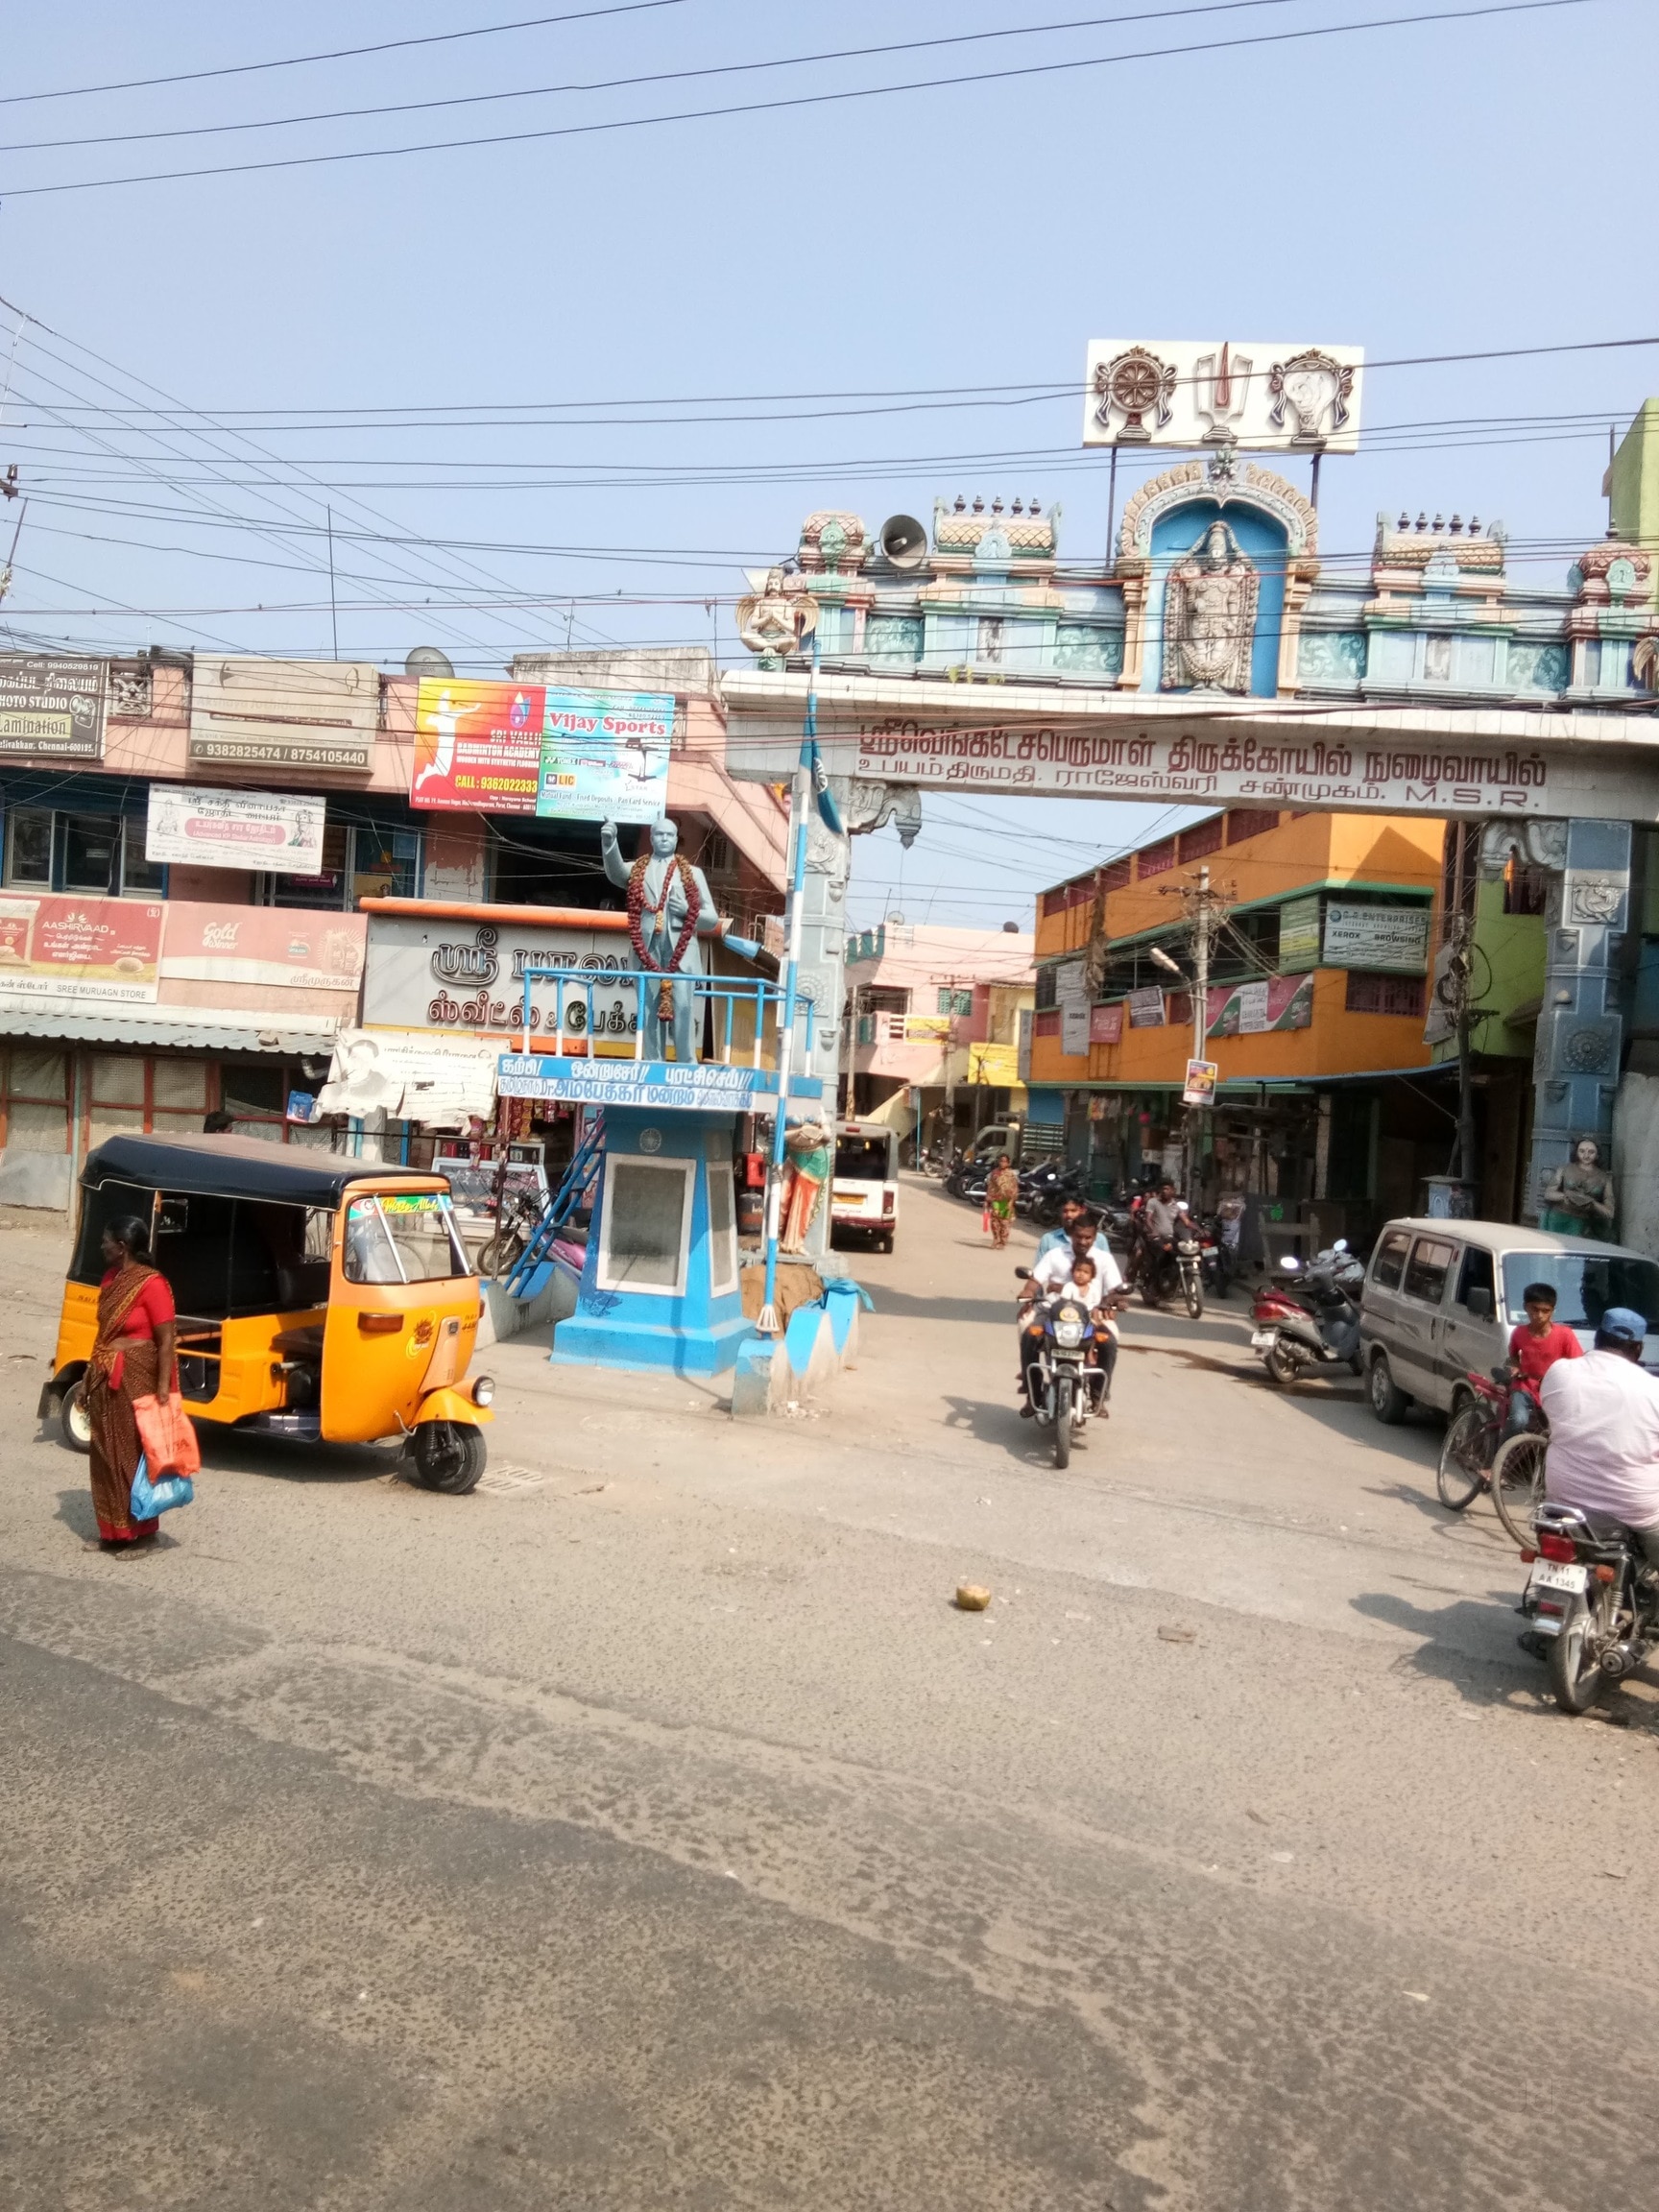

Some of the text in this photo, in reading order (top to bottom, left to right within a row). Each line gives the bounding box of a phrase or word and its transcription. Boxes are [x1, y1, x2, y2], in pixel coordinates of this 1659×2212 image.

[27, 661, 46, 669] Cell:
[0, 695, 68, 709] HOTO STUDIO
[0, 715, 67, 735] amination
[549, 712, 666, 735] Vijay Sports
[206, 743, 281, 759] 9382825474
[290, 749, 366, 765] 8754105440
[1167, 734, 1353, 777] திருக்கோயில்
[1362, 751, 1547, 787] நுழைவாயில்
[455, 774, 475, 788] CALL
[480, 777, 539, 793] 9362022333
[559, 775, 574, 785] LIC
[42, 922, 109, 933] AASHIRVAAD
[203, 922, 242, 943] Gold
[1332, 930, 1421, 944] XEROX BROWSING
[57, 985, 147, 999] SREE MURUAGN STORE
[1548, 1563, 1559, 1573] TN
[1555, 1577, 1575, 1589] 1345
